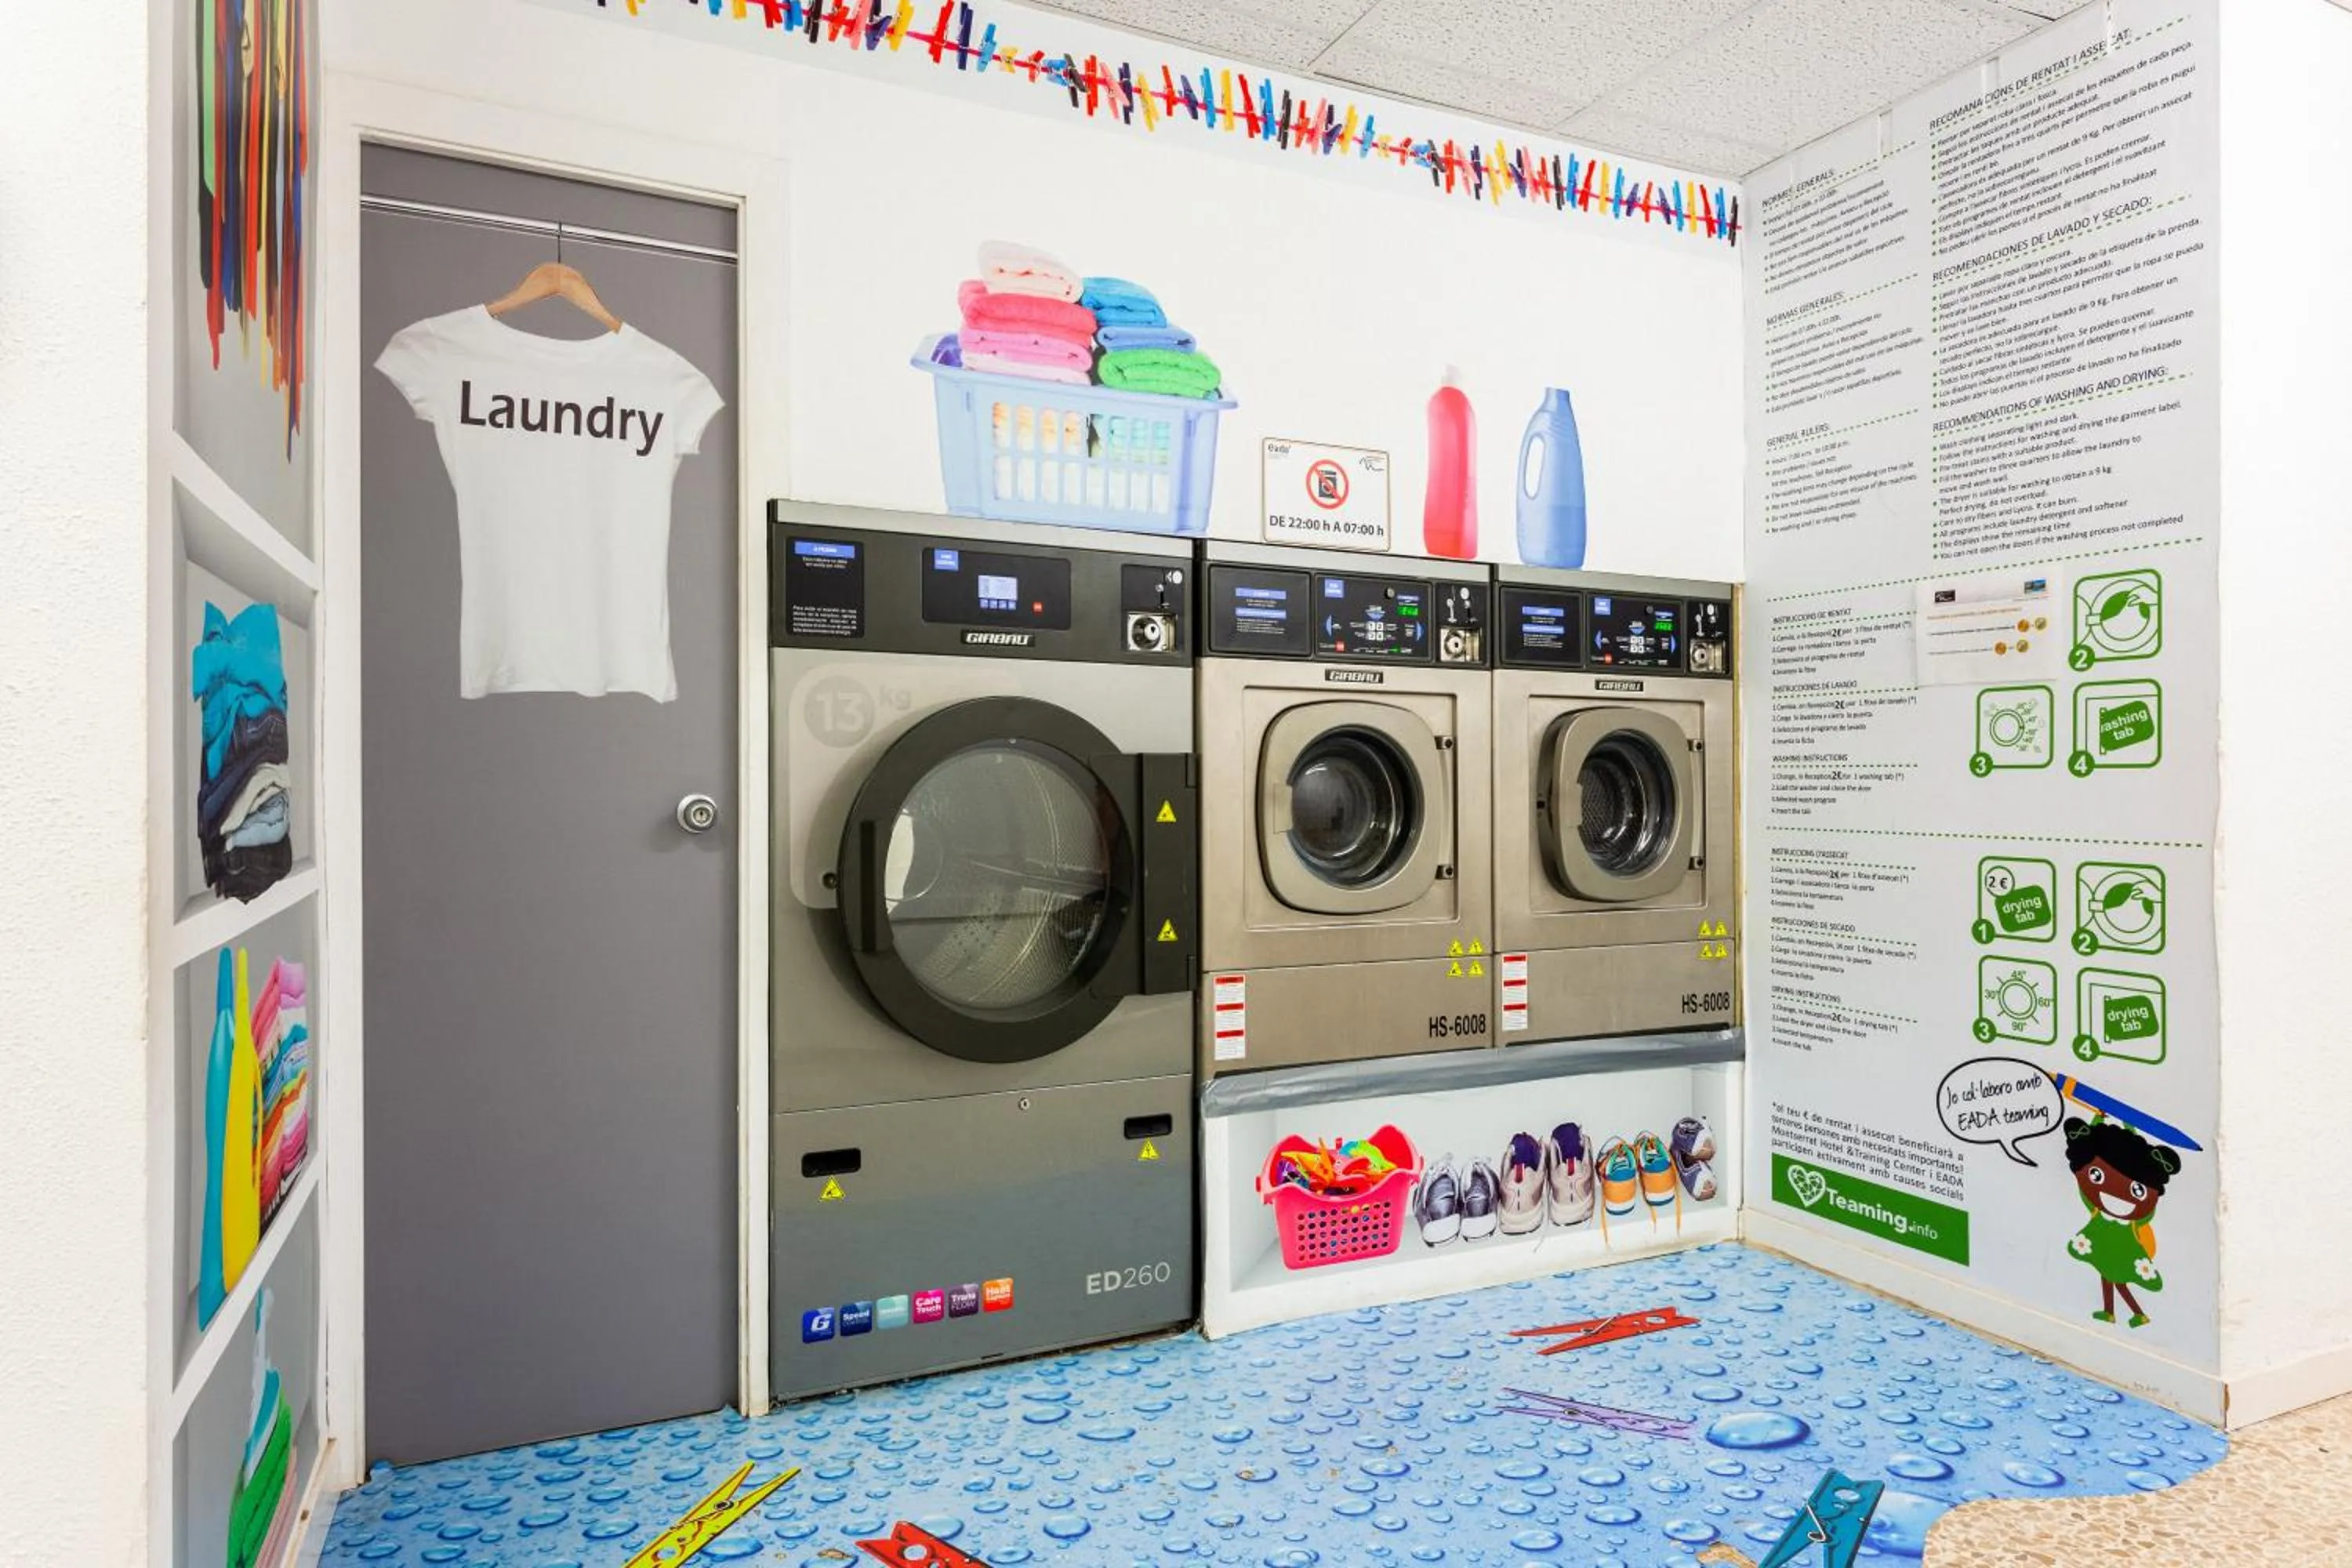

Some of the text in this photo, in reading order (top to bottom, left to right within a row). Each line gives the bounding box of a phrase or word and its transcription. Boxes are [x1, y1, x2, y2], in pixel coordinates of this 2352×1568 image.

[2016, 74, 2027, 90] DE
[2031, 55, 2068, 82] RENTAT
[1933, 238, 2027, 281] RECOMENDACIONES
[2031, 232, 2045, 246] DE
[2047, 216, 2089, 241] LAVADO
[2092, 212, 2099, 225] Y
[2103, 194, 2151, 221] SECADO:
[1933, 364, 2169, 431] RECOMMENDATIONS OF WASHING AND DRYING:
[460, 379, 664, 457] Laundry
[2062, 423, 2076, 434] and
[2105, 414, 2118, 424] the
[2121, 405, 2154, 423] garment
[1767, 430, 1798, 447] GENERAL
[2085, 442, 2096, 452] the
[2078, 504, 2092, 514] and
[1269, 515, 1384, 536] DE 22:00 h A 07:00 h
[2089, 525, 2119, 538] process
[2122, 521, 2135, 531] not
[2137, 514, 2183, 531] completed
[965, 633, 1031, 646] GIRBAU
[2075, 649, 2088, 668] 2
[815, 684, 911, 733] 13 kg
[2113, 727, 2135, 741] tab
[1976, 757, 1987, 774] 3
[2074, 755, 2088, 774] 4
[1987, 875, 2008, 890] 2 €
[2002, 895, 2042, 914] drying
[2014, 910, 2035, 924] tab
[1978, 924, 1987, 935] 1
[2078, 934, 2091, 952] 2
[1682, 992, 1730, 1014] HS-6008
[2107, 1005, 2149, 1022] drying
[1429, 1014, 1486, 1038] HS-6008
[1979, 1023, 1990, 1038] 3
[2121, 1020, 2141, 1033] tab
[2078, 1040, 2092, 1057] 4
[2015, 1073, 2042, 1092] amb
[1958, 1104, 2049, 1131] EADA teaming
[1786, 1107, 1800, 1118] teu
[1812, 1113, 1822, 1123] de
[1825, 1117, 1851, 1131] rentat
[1862, 1127, 1894, 1143] assecat
[1898, 1136, 1952, 1159] beneficiarà
[1804, 1125, 1839, 1142] persones
[1842, 1134, 1860, 1146] amb
[1908, 1151, 1963, 1177] importants!
[1771, 1138, 1963, 1201] participen activament amb causes socials
[1820, 1139, 1842, 1153] Hotel
[1893, 1160, 1924, 1177] Center
[1936, 1171, 1963, 1188] EADA
[1085, 1261, 1172, 1295] ED260
[915, 1296, 942, 1307] Care
[916, 1305, 942, 1315] Touch
[811, 1313, 832, 1332] G
[843, 1308, 870, 1321] Speed
